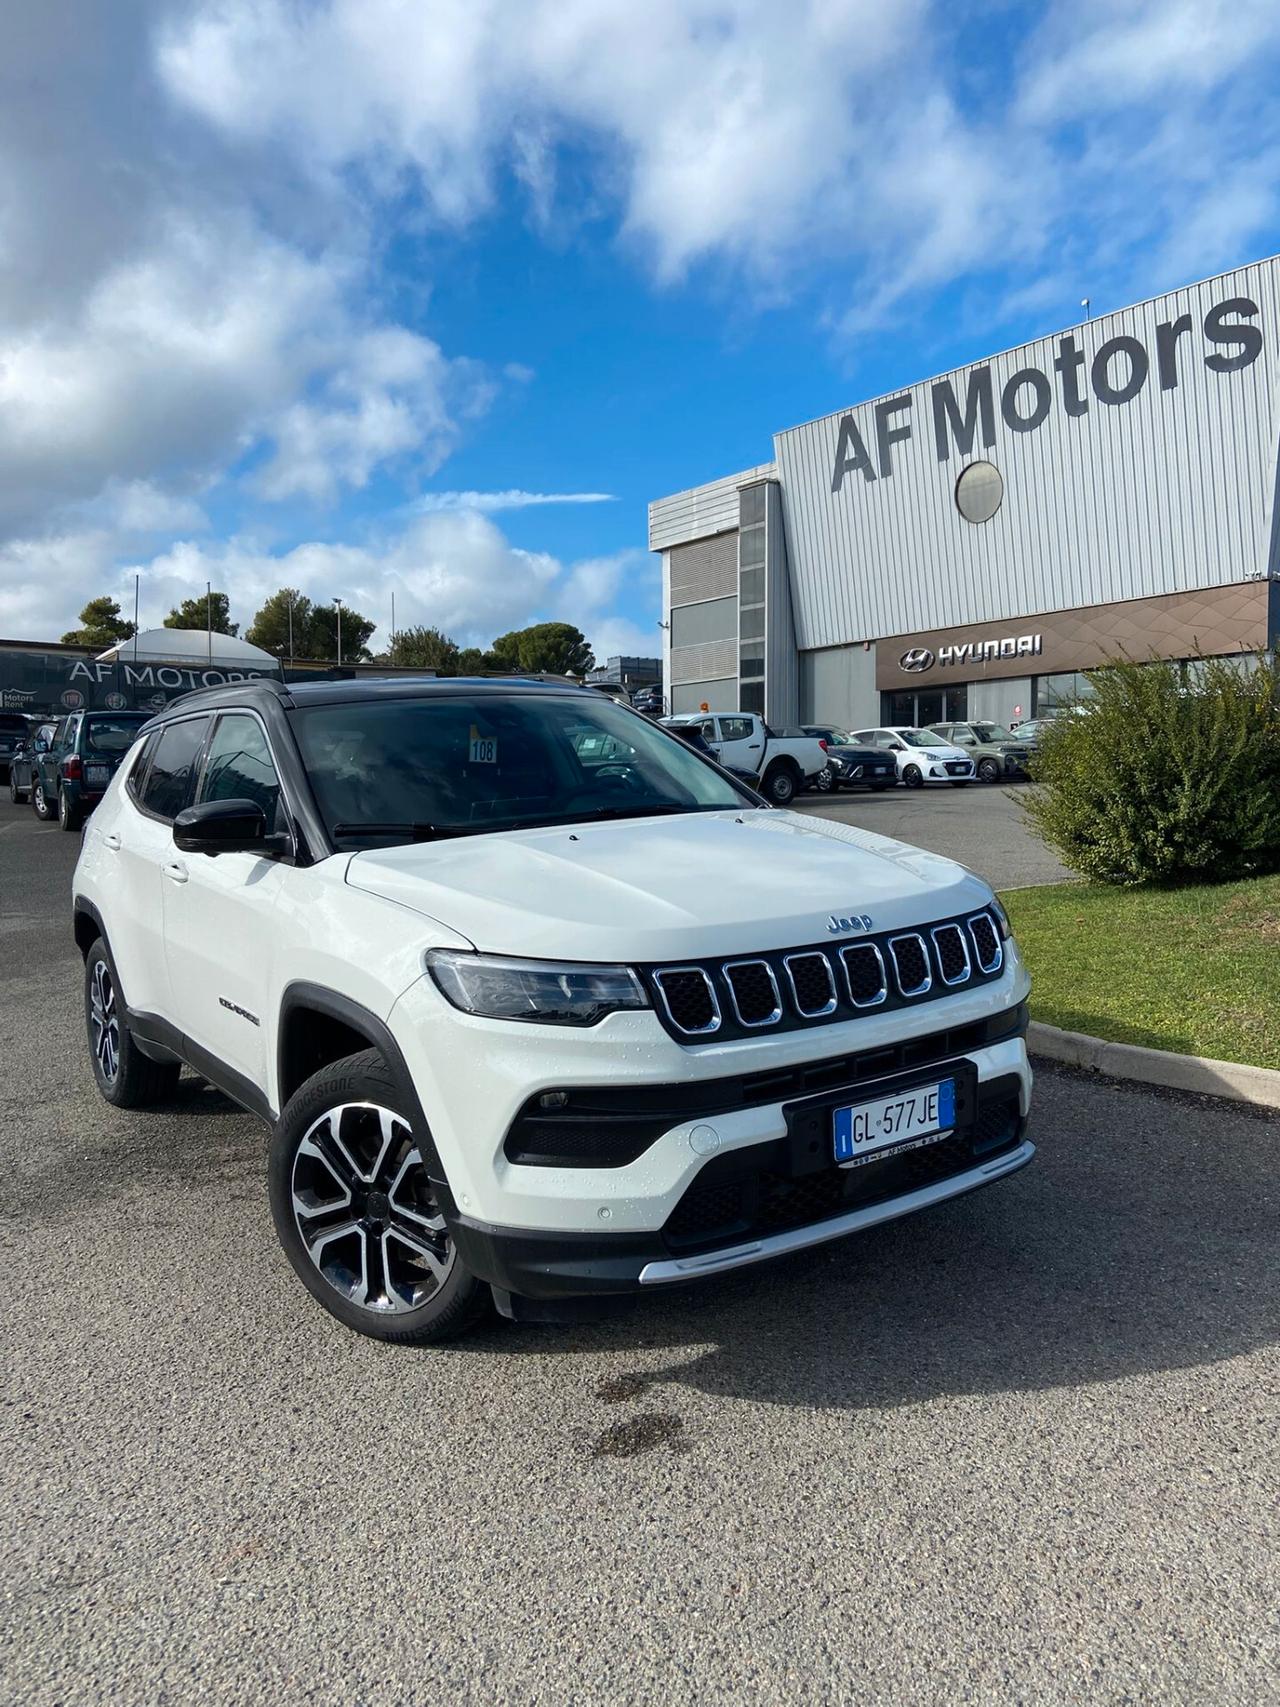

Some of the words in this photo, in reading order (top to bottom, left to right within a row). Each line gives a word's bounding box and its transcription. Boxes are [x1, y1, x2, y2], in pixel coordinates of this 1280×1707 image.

[832, 393, 913, 493] AF
[931, 297, 1263, 462] Motors
[938, 634, 1042, 667] HYUNDAI
[69, 661, 112, 682] AF
[473, 741, 493, 761] 108
[826, 915, 873, 934] Jeep
[853, 1112, 876, 1144] GL
